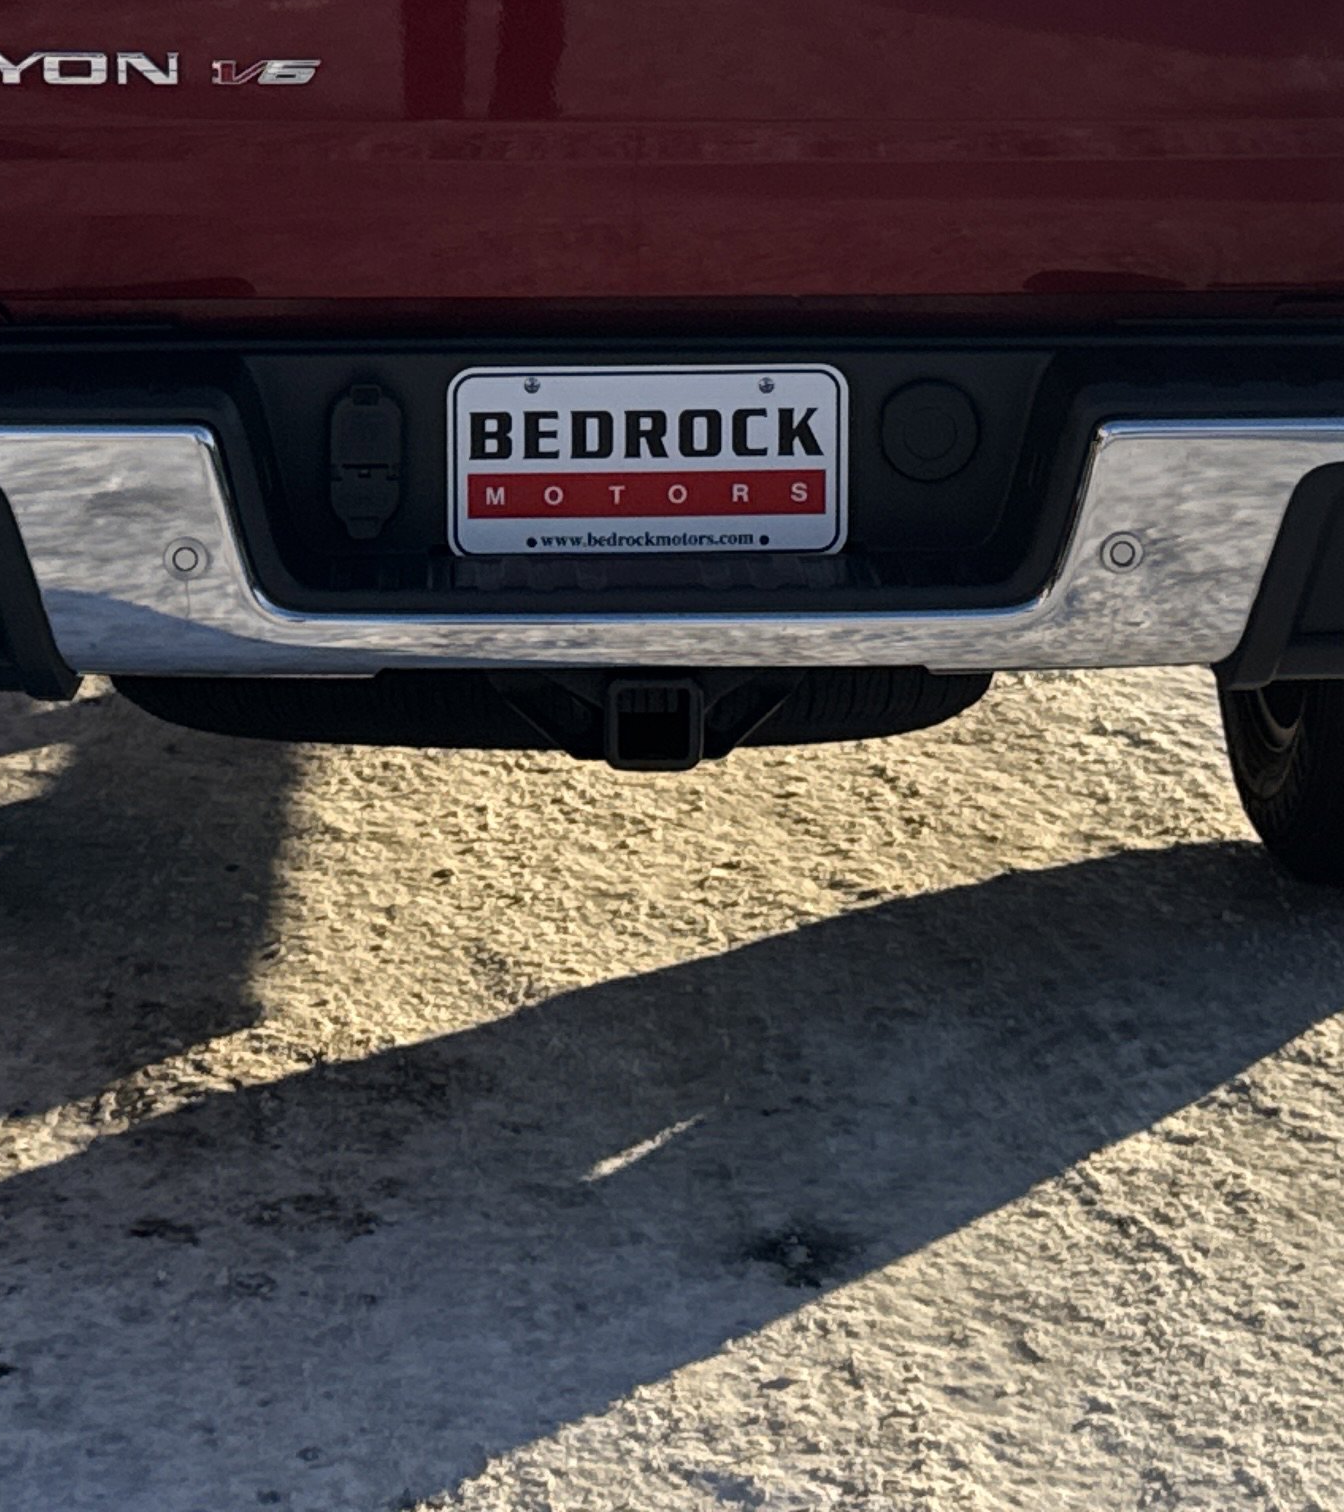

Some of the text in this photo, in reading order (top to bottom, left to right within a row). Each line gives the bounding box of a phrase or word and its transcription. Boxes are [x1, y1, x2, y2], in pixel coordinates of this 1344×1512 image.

[211, 59, 321, 85] V6
[468, 407, 824, 460] BEDROCK
[485, 482, 808, 506] MOTORS
[540, 529, 754, 547] www.bedrockmotors.com
